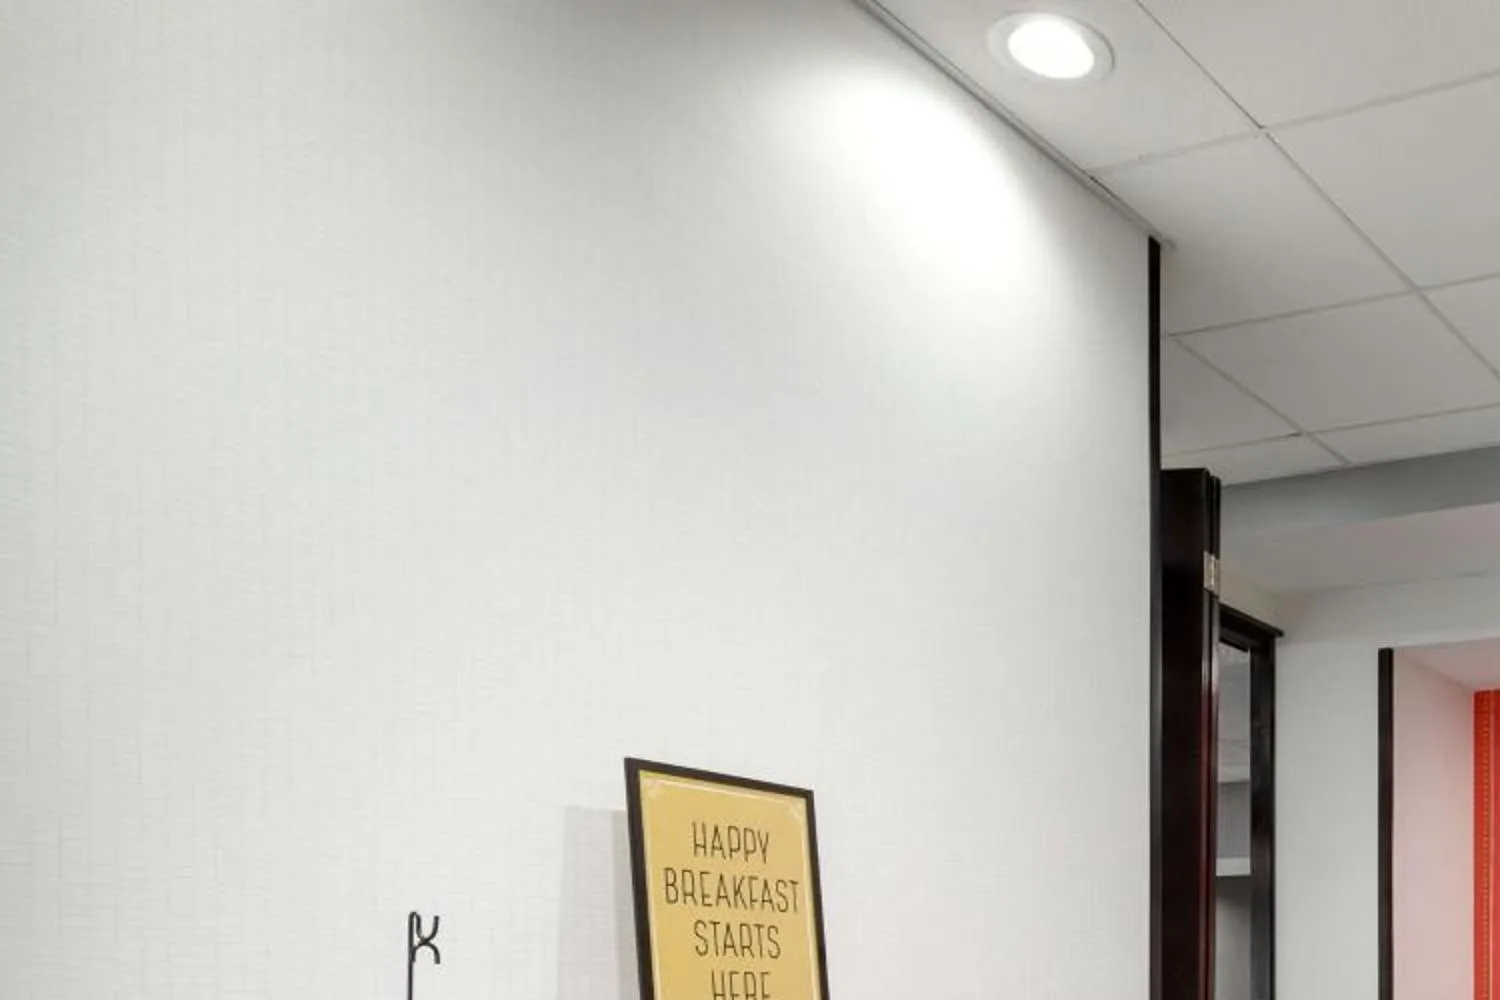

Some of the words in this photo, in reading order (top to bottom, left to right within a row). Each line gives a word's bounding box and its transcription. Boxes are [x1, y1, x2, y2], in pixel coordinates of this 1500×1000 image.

[692, 821, 770, 864] HAPPY
[664, 867, 800, 914] BREAKFAST
[693, 919, 781, 959] STARTS
